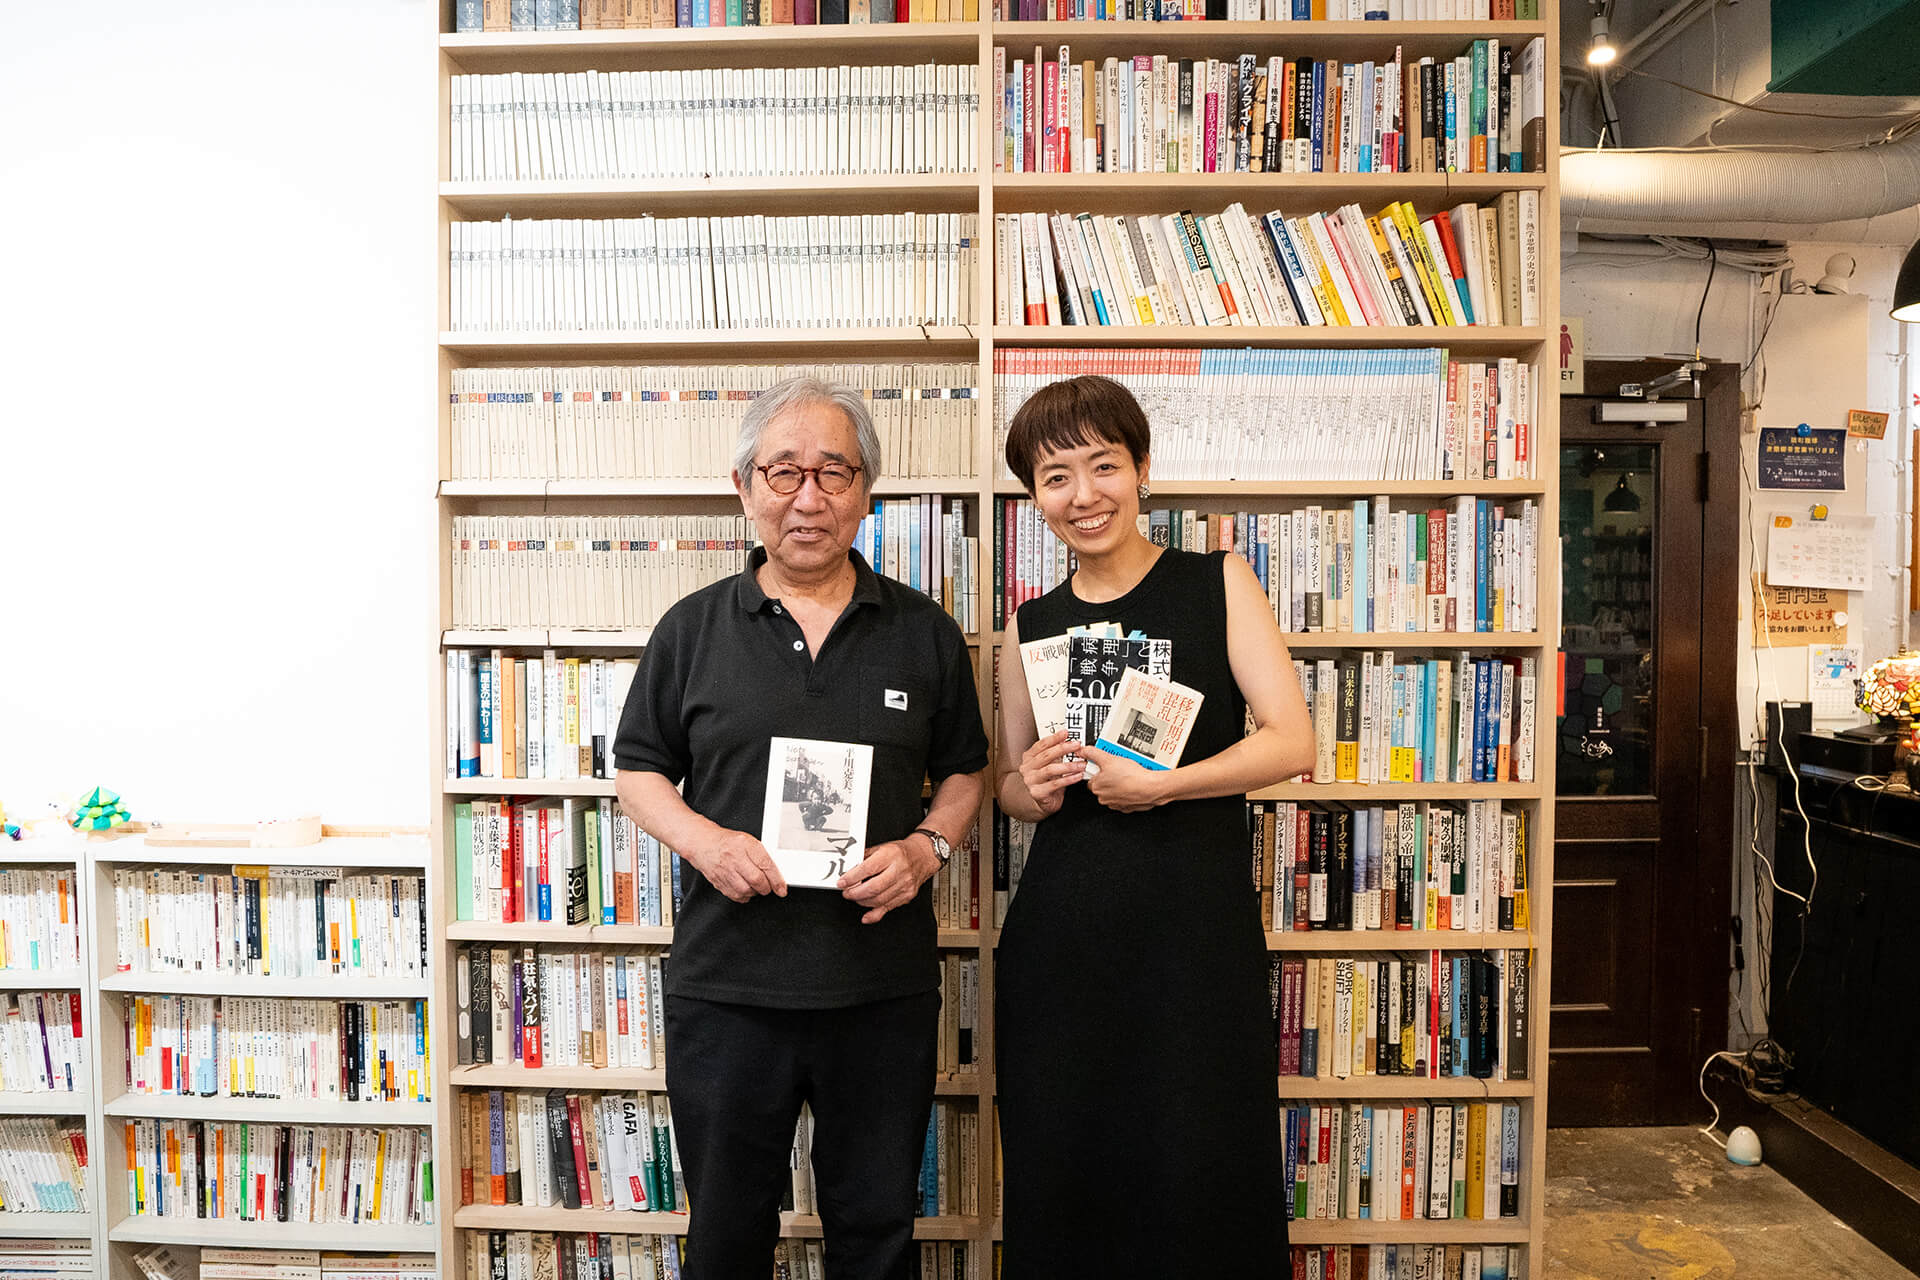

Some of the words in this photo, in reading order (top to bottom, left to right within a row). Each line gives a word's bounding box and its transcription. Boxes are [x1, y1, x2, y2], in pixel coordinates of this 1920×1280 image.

[1183, 214, 1209, 269] 選択の自由
[1526, 222, 1537, 293] 熱学思想の史的展開
[1759, 609, 1836, 621] 不足しています
[1775, 587, 1828, 604] 百円玉
[1152, 641, 1171, 680] 株式
[1134, 720, 1157, 736] DEAD
[1156, 690, 1180, 723] 混乱
[1160, 696, 1195, 756] 移行期的
[1342, 664, 1355, 738] 「日米安保」とは何か
[1337, 812, 1349, 871] ダーク・マネー
[1400, 806, 1414, 869] 強欲の帝国
[1440, 815, 1452, 863] 神々の崩壊
[472, 950, 482, 1013] エクソダス
[480, 950, 491, 1013] 希望の国の
[522, 961, 539, 1027] 狂気とバブル
[1335, 961, 1345, 996] SHIFT
[1344, 960, 1353, 996] WORK
[1514, 951, 1526, 1014] 歴史人口学研究
[622, 1102, 638, 1136] GAFA
[1352, 1110, 1362, 1166] チーズバーガーズ
[1507, 1108, 1517, 1157] あかんやつら
